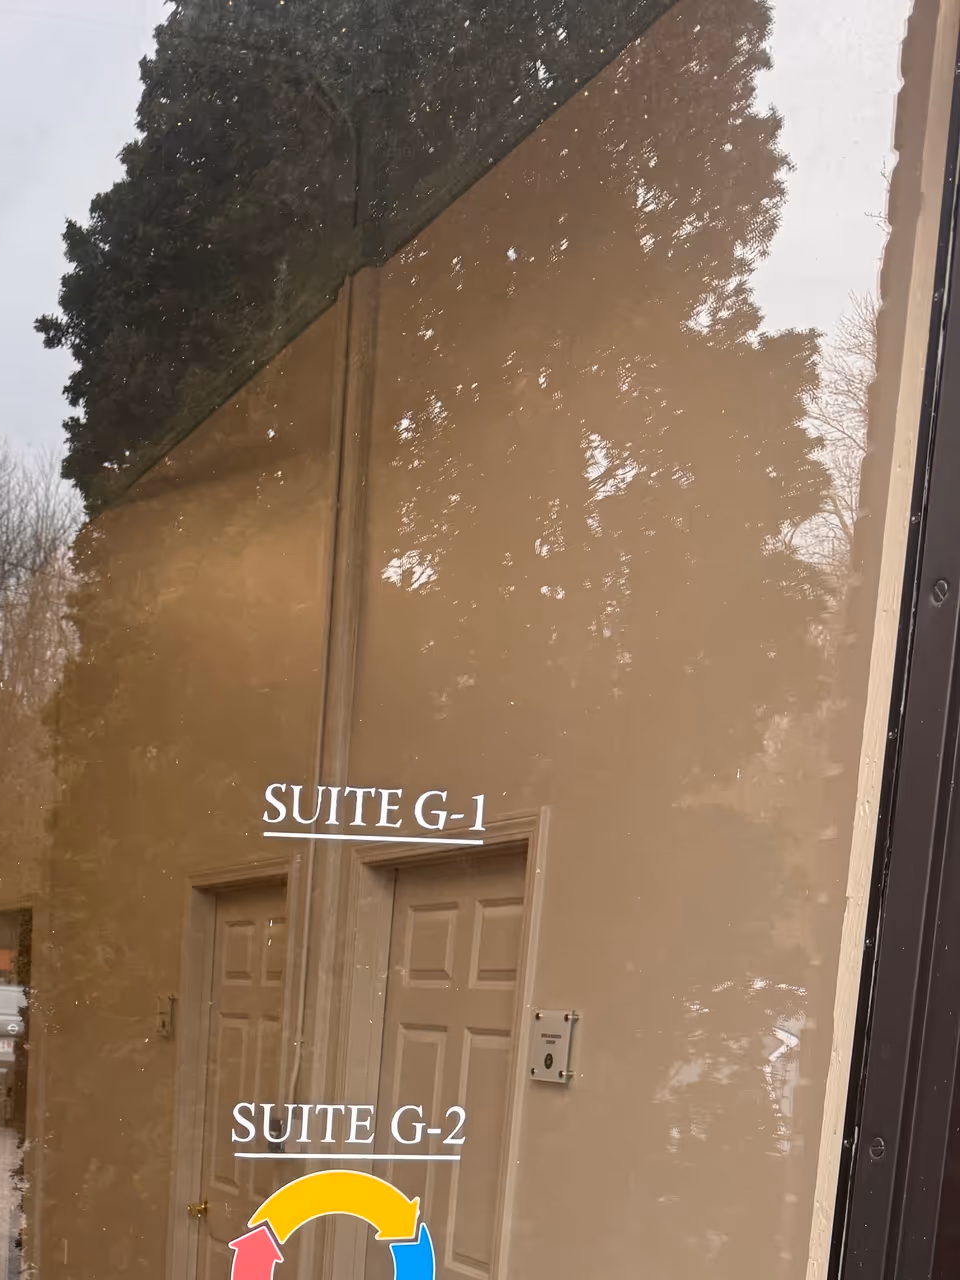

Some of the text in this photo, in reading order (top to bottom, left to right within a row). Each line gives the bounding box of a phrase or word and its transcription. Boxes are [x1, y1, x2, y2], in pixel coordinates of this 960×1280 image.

[262, 783, 486, 831] SUITE G-1
[231, 1102, 467, 1145] SUITE G-2
